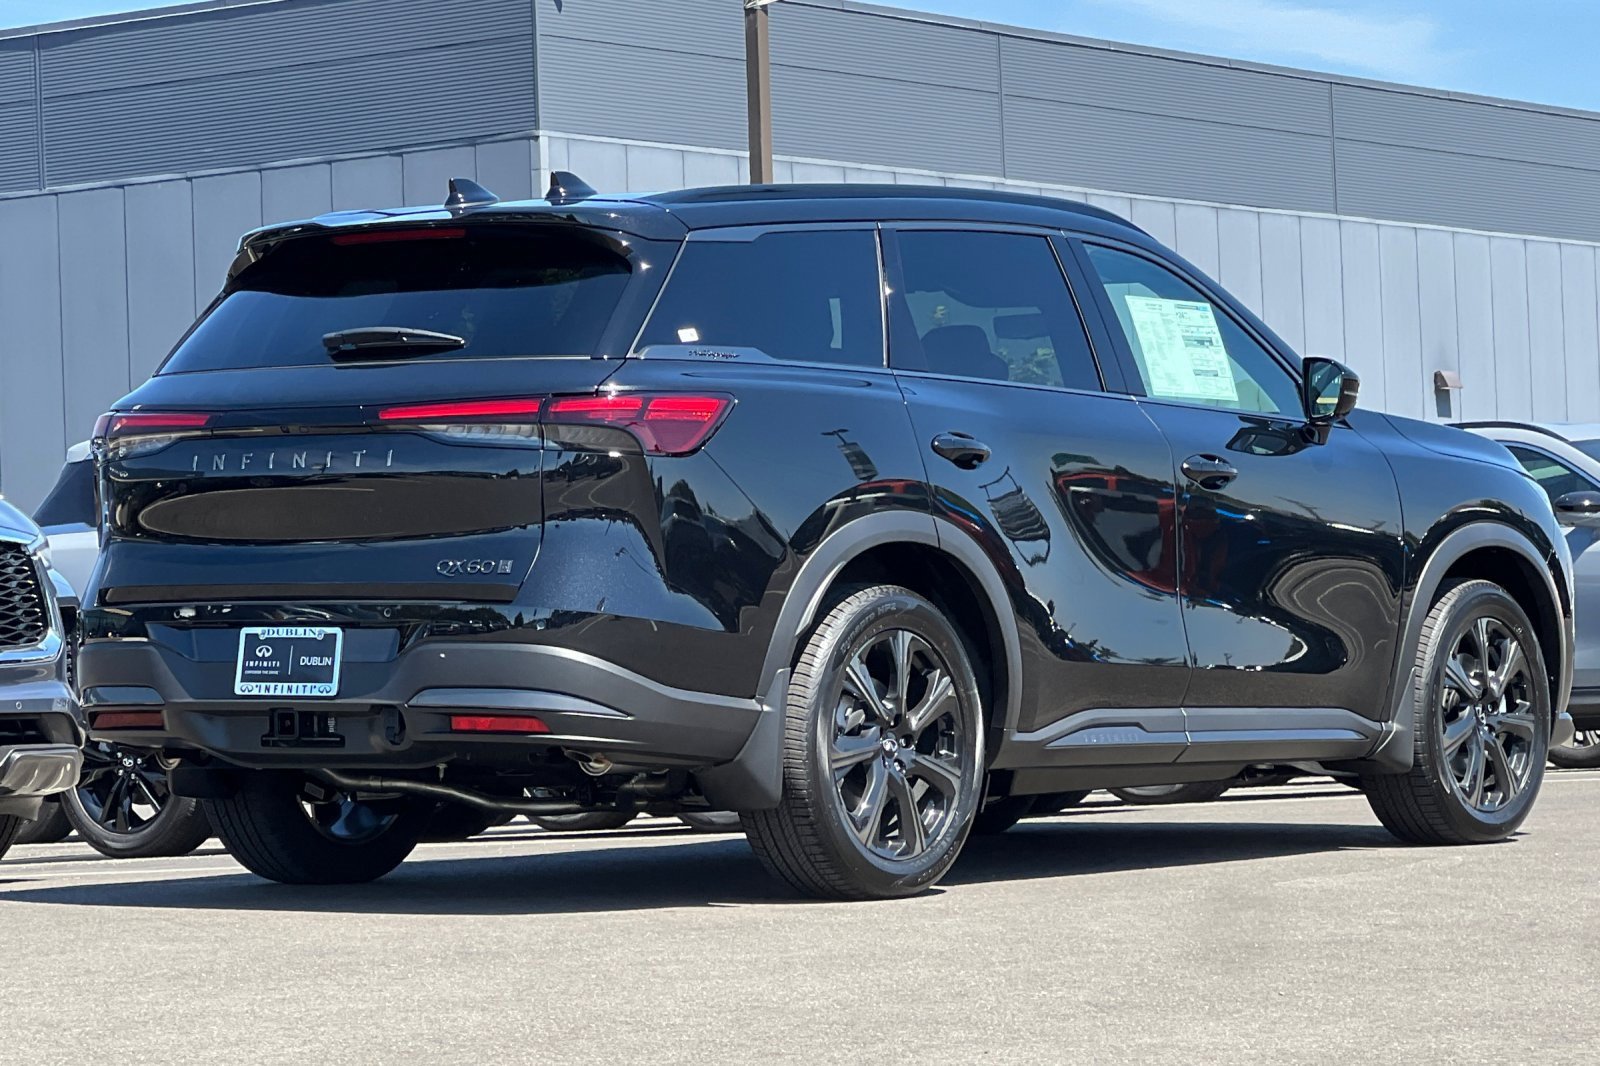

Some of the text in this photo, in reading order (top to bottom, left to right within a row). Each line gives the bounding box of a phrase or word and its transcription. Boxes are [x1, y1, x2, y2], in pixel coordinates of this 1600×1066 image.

[192, 450, 394, 471] INFINITI
[436, 559, 495, 576] QX60
[267, 628, 317, 637] DUBLIN
[300, 656, 332, 666] DUBLIN
[258, 684, 314, 694] INFINITI
